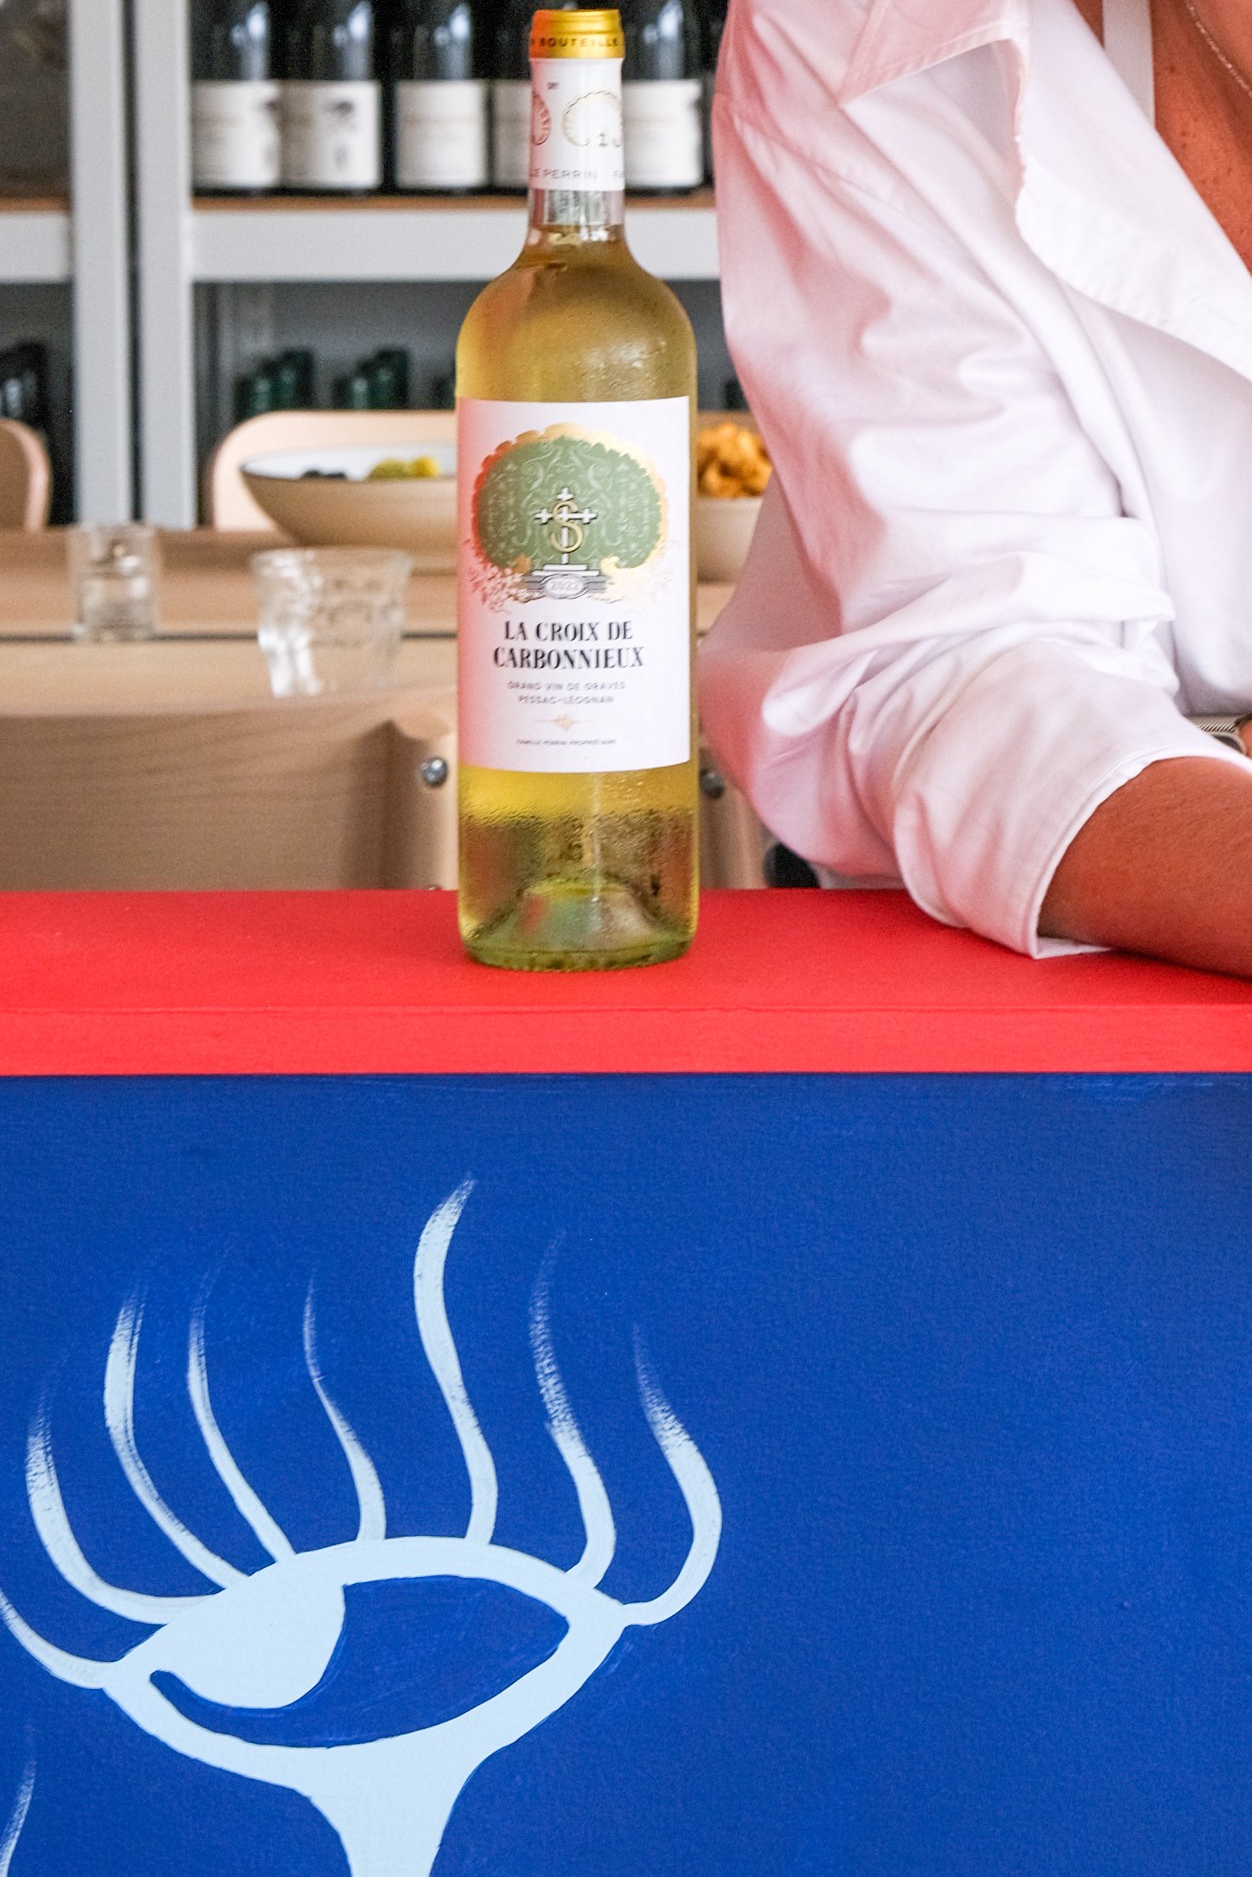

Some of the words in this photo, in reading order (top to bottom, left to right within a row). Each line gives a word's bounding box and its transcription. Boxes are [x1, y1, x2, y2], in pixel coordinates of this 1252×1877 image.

[539, 37, 619, 48] BOUTEILLE
[542, 168, 598, 180] PERRIN
[504, 620, 528, 641] LA
[536, 621, 601, 642] CROIX
[607, 620, 633, 641] DE
[493, 646, 644, 670] CARBONNIEUX
[507, 680, 542, 691] GRAND
[545, 682, 564, 691] VIN
[566, 682, 581, 691] DE
[584, 680, 625, 691] GRAVES
